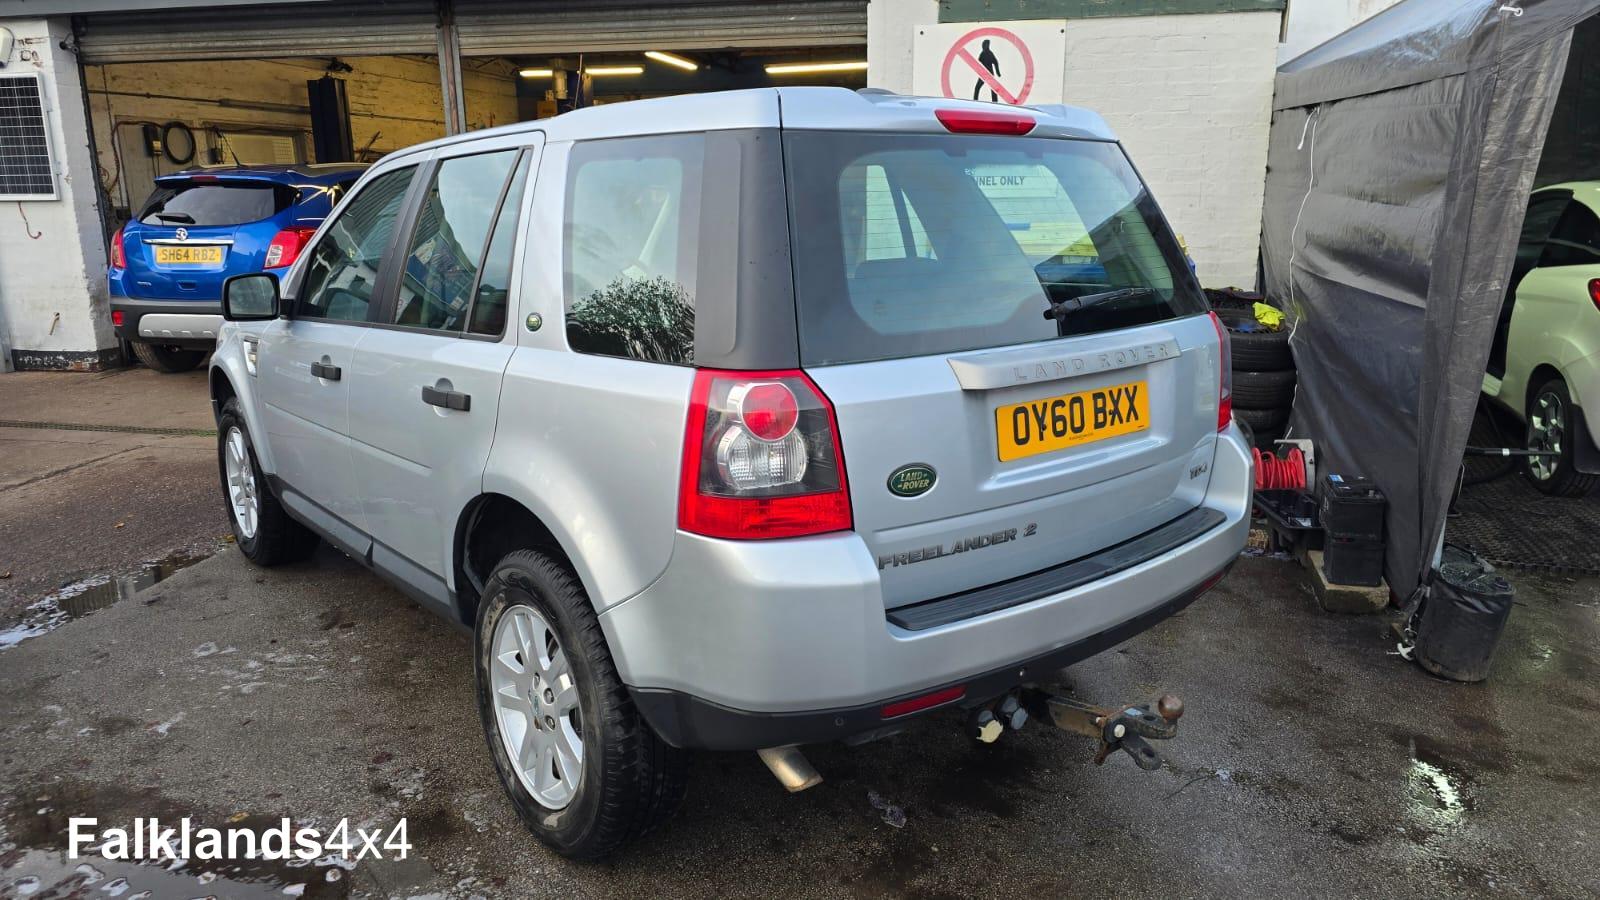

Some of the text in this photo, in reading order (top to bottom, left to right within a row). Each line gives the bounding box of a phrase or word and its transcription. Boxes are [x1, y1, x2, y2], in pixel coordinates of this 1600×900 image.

[976, 176, 1025, 186] NEL ONLY
[161, 249, 216, 261] SH64 RBZ
[1013, 343, 1168, 381] LAND ROVER
[1013, 385, 1139, 446] OY60 BXX
[900, 471, 923, 482] LAND
[902, 479, 930, 490] ROVER
[878, 522, 1038, 570] FREELANDER 2
